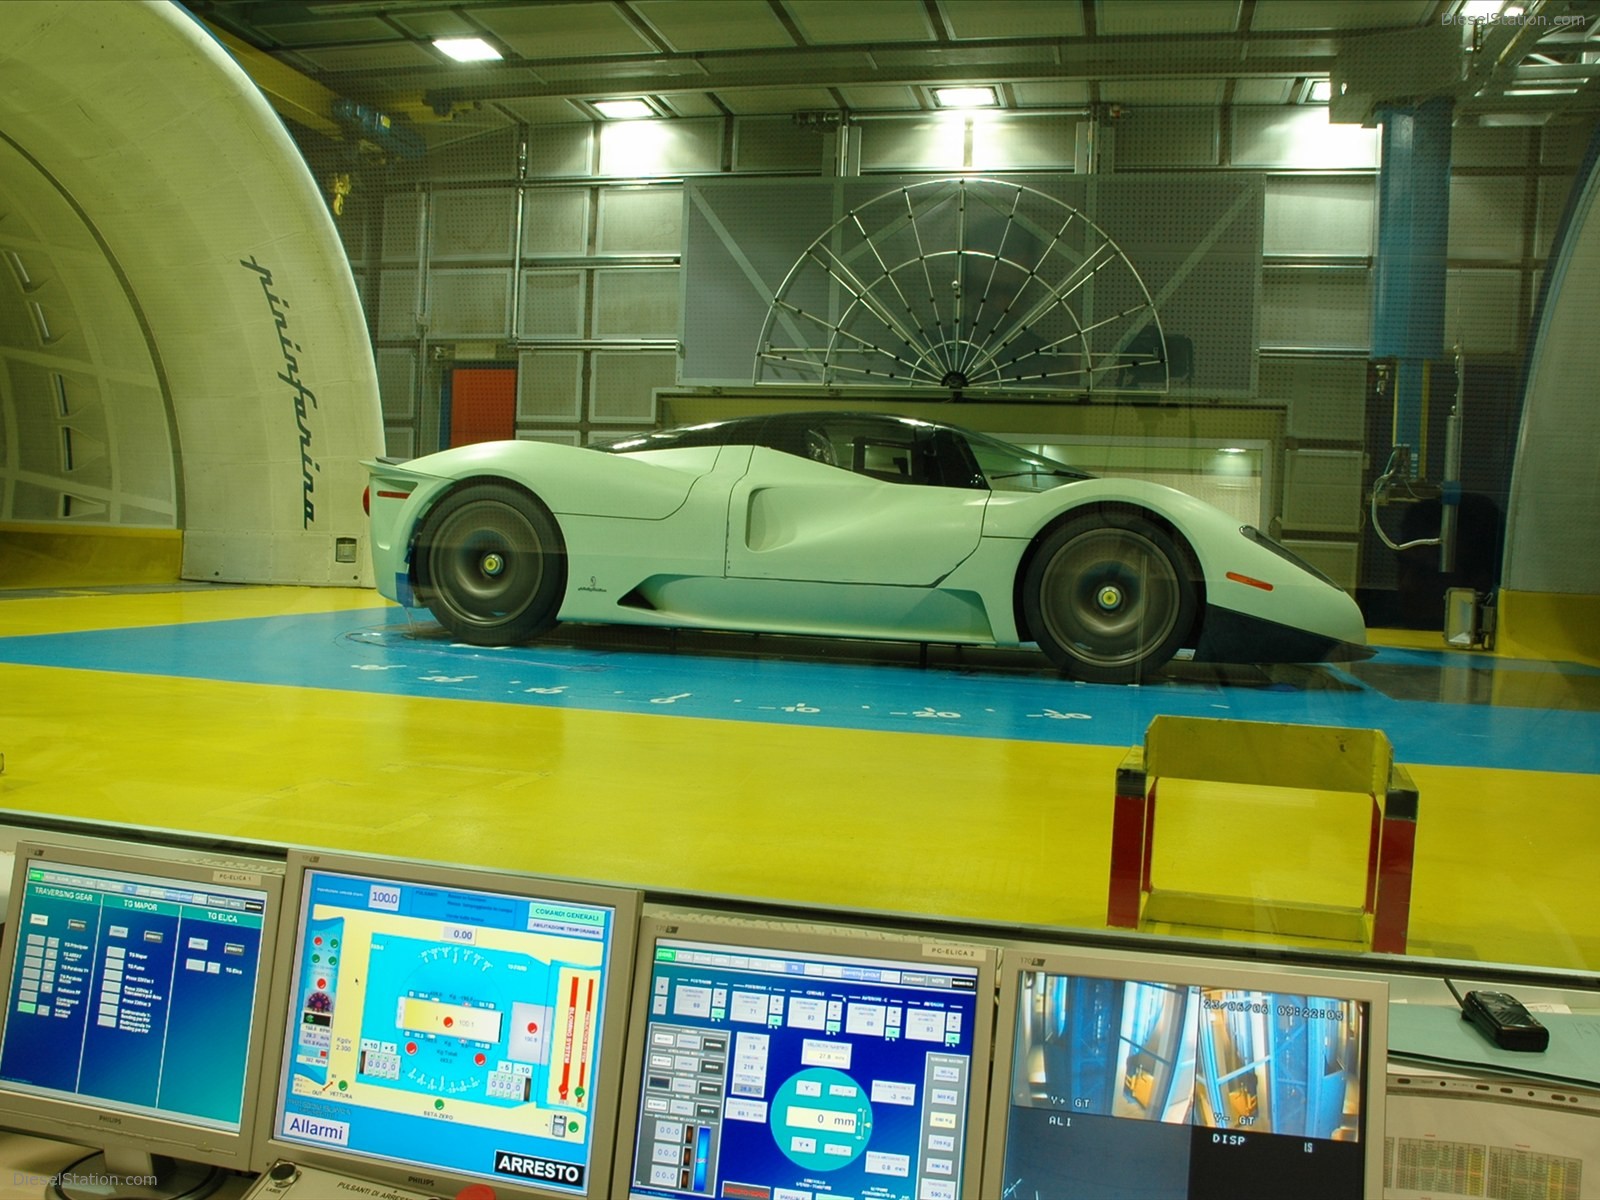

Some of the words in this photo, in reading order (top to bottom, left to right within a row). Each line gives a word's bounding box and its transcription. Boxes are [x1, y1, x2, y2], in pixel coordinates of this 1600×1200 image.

[240, 255, 320, 530] pininfarina
[34, 886, 75, 899] TRAVERSING
[74, 892, 93, 901] GEAR
[372, 891, 398, 904] 100.0
[123, 899, 133, 908] TG
[134, 901, 158, 911] MAPOR
[207, 911, 217, 920] TG
[218, 913, 238, 923] ELICA
[535, 908, 566, 918] COMANDI
[567, 911, 599, 921] GENERALI
[453, 930, 473, 940] 0.00
[931, 947, 968, 956] PC-ELICA
[1203, 1000, 1268, 1014] 23/06/06
[1277, 1004, 1344, 1021] 09:22:05
[329, 1091, 353, 1099] VETTURA
[1050, 1095, 1065, 1104] Y+
[1074, 1098, 1090, 1108] GT
[423, 1110, 438, 1118] BETA
[817, 1114, 824, 1123] 0
[834, 1117, 855, 1127] mm
[1239, 1115, 1254, 1125] GT
[1048, 1115, 1072, 1127] ALI
[290, 1118, 343, 1140] Allarmi
[1212, 1133, 1246, 1146] DISP
[498, 1155, 579, 1182] ARRESTO
[407, 1176, 435, 1187] PHILIPS
[337, 1181, 371, 1195] PULSANTI
[371, 1189, 380, 1197] DI
